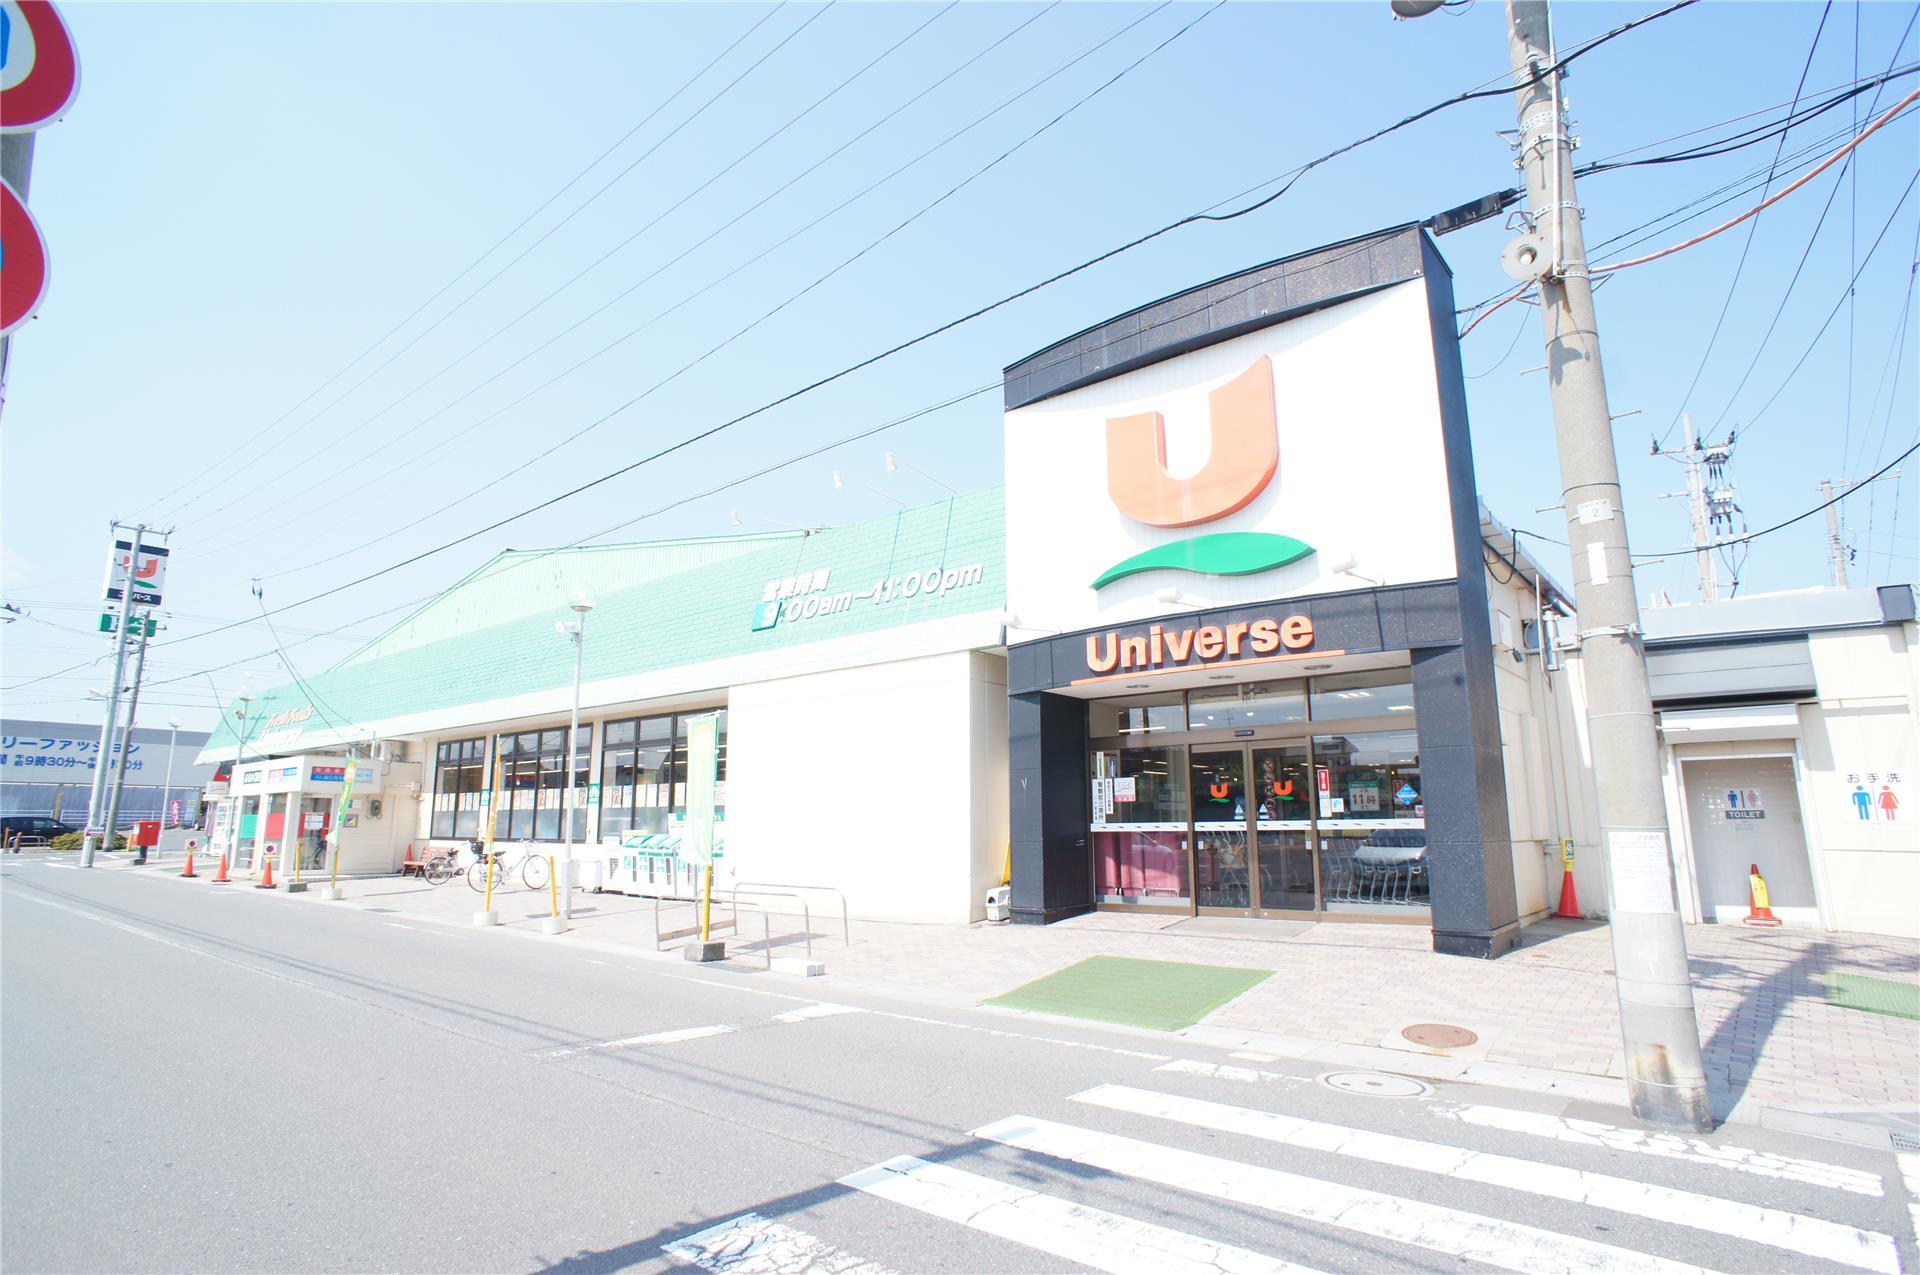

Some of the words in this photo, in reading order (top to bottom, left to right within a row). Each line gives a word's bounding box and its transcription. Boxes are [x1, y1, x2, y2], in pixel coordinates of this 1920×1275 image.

[1105, 354, 1279, 529] U
[1086, 614, 1315, 674] Universe
[1728, 810, 1762, 819] TOILET
